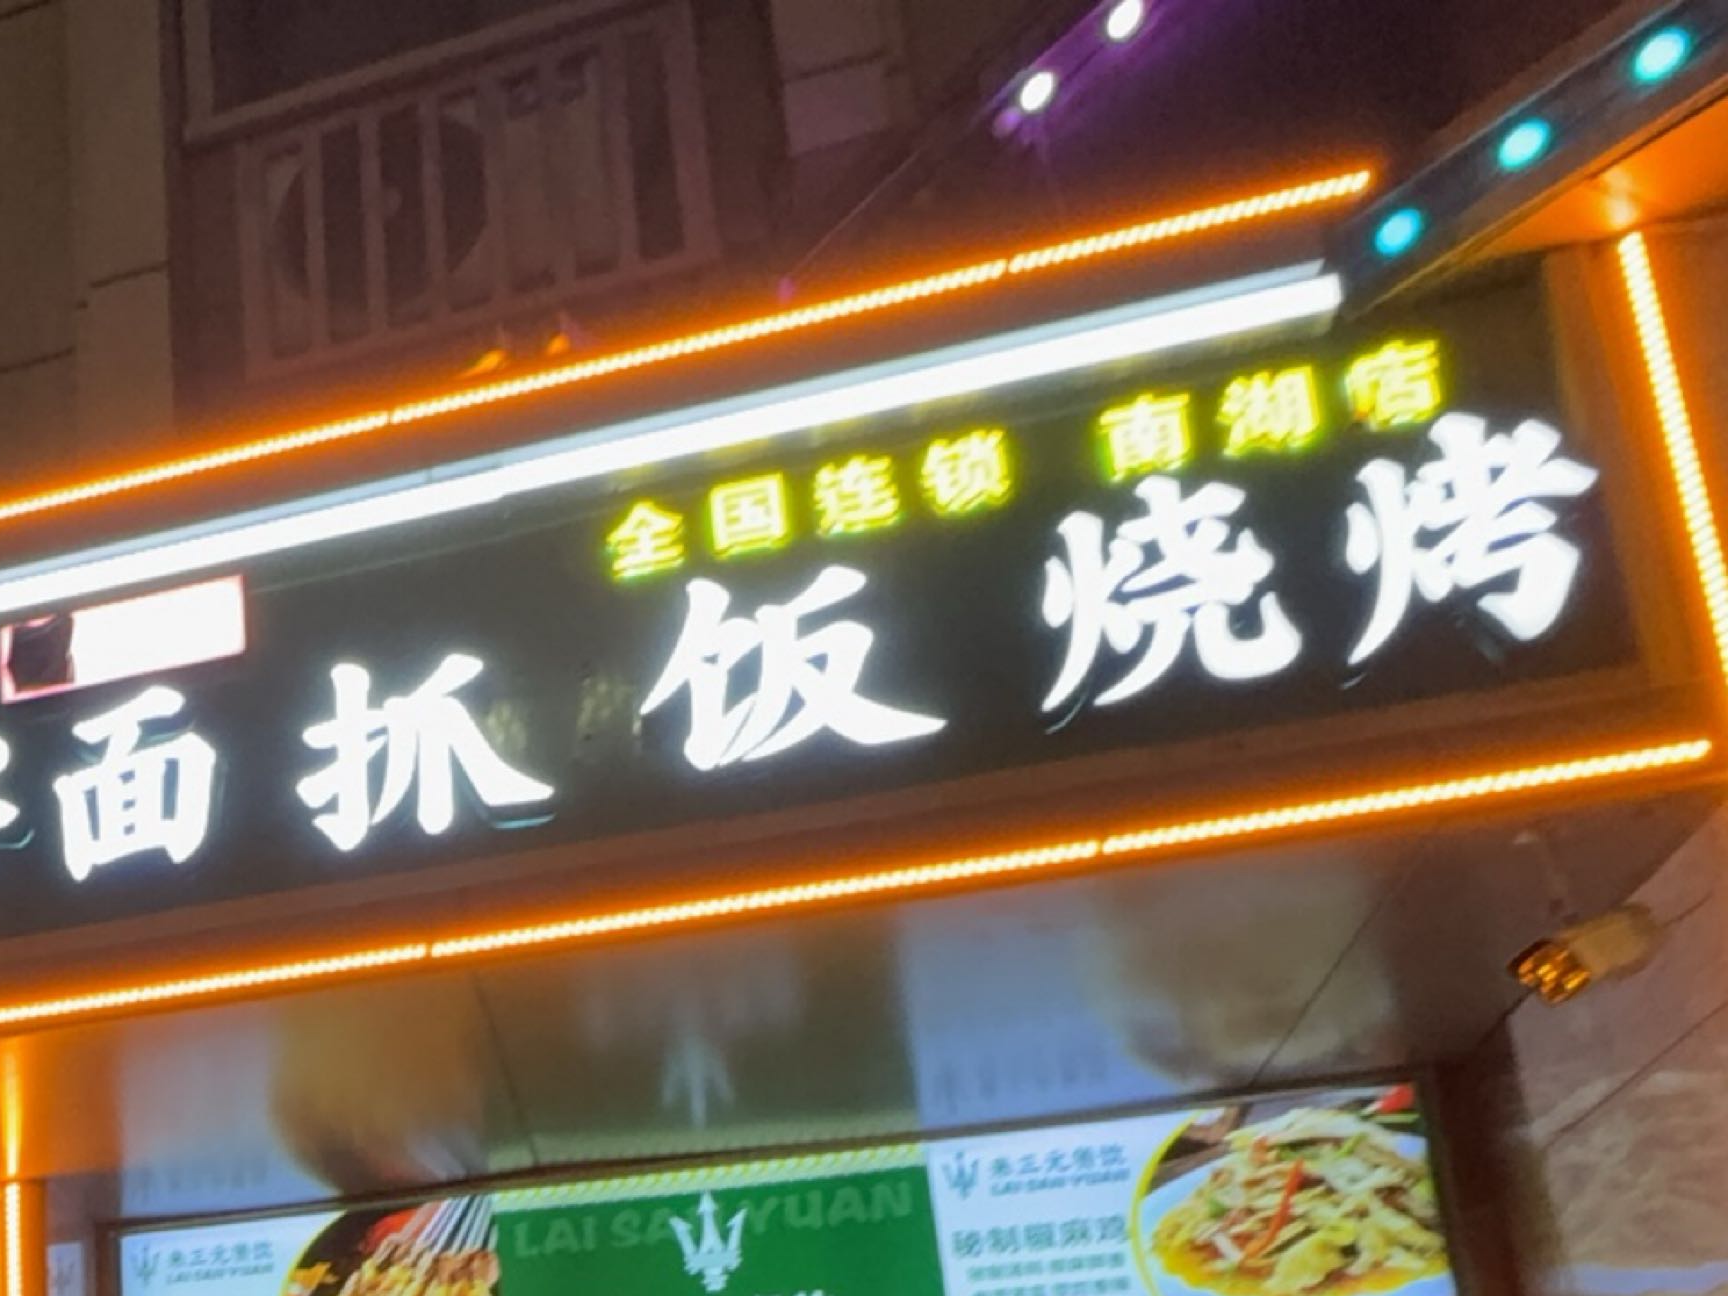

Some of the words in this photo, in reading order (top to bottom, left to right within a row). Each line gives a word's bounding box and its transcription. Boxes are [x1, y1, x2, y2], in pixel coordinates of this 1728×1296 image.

[606, 430, 1011, 582] 全国连锁
[1097, 338, 1443, 481] 南湖店
